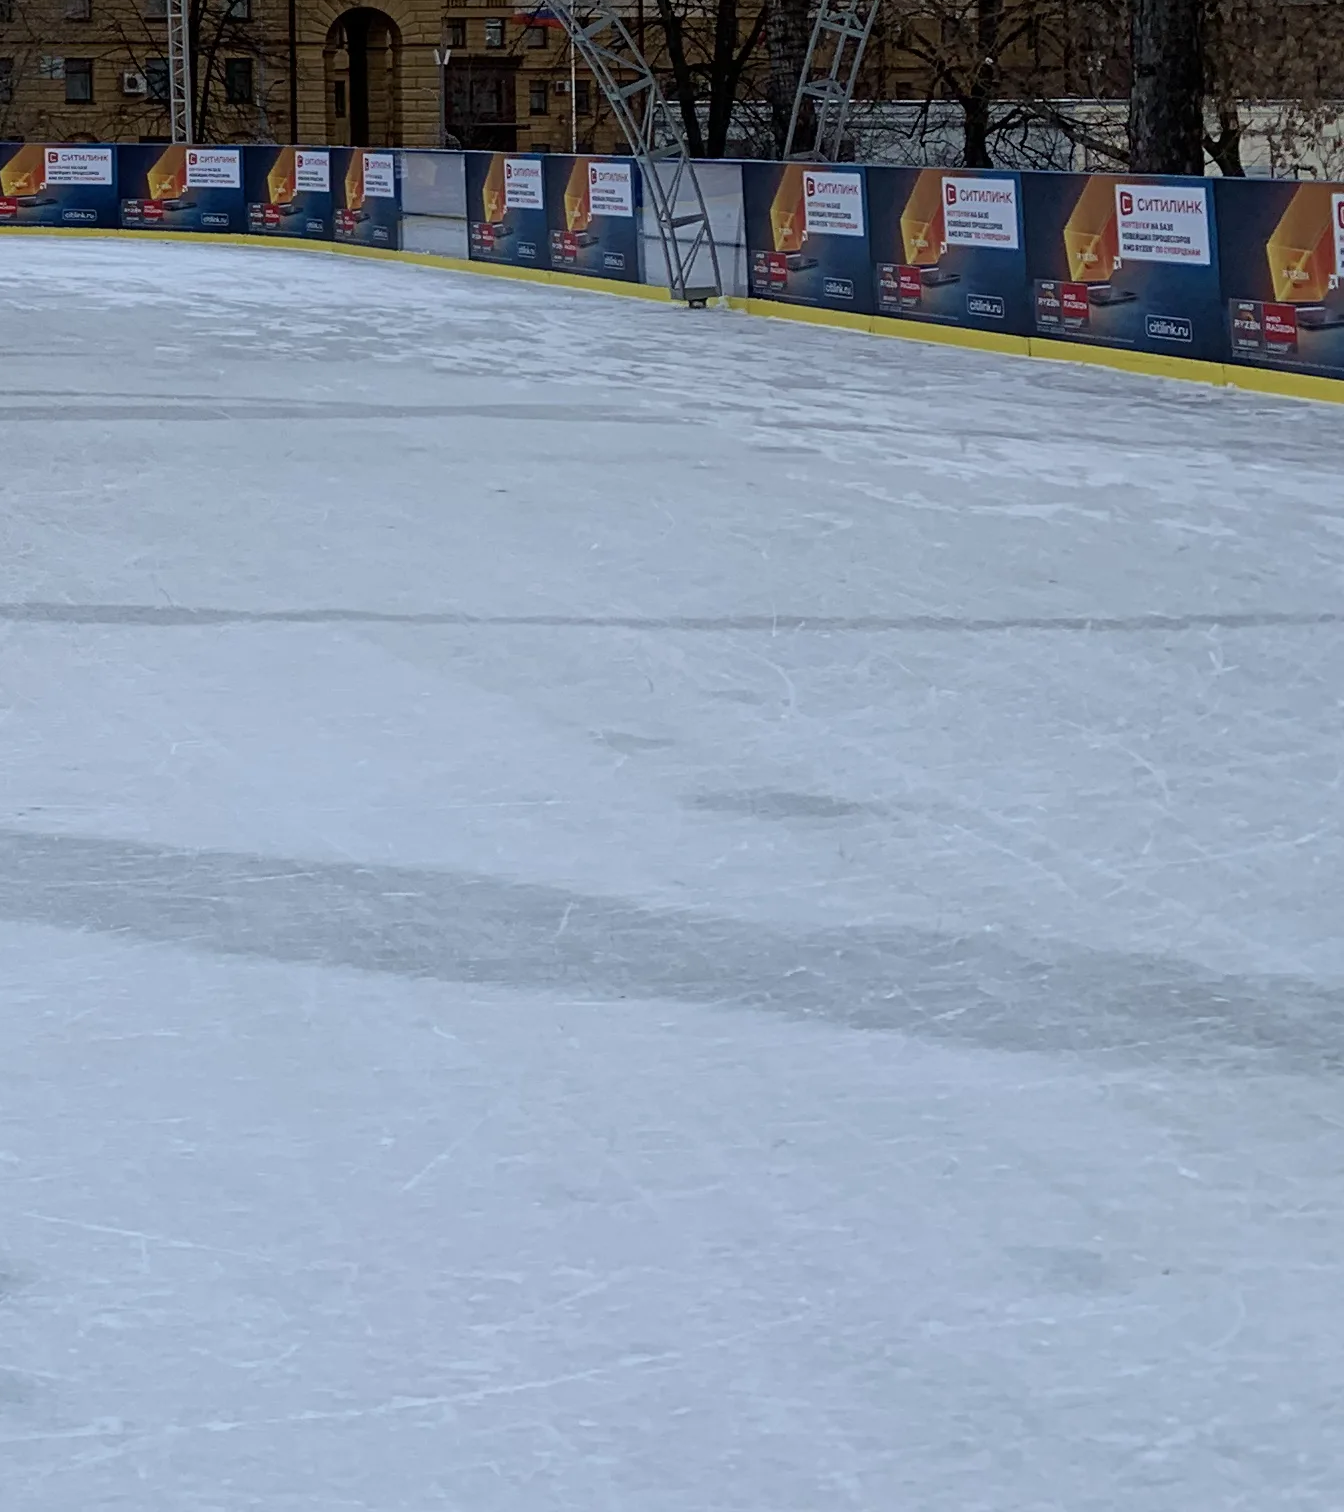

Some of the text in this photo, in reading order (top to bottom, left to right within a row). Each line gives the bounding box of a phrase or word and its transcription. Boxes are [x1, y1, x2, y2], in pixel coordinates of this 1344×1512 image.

[61, 154, 108, 162] СИТИЛИНК
[817, 182, 859, 195] СИТИЛИНК
[960, 189, 1013, 204] СИТИЛИНК
[1137, 198, 1203, 214] СИТИЛИНК
[970, 299, 1001, 313] citilink.ru
[1149, 320, 1189, 337] citilink.ru
[1234, 318, 1261, 330] RYZEN
[1266, 323, 1295, 334] RADEON
